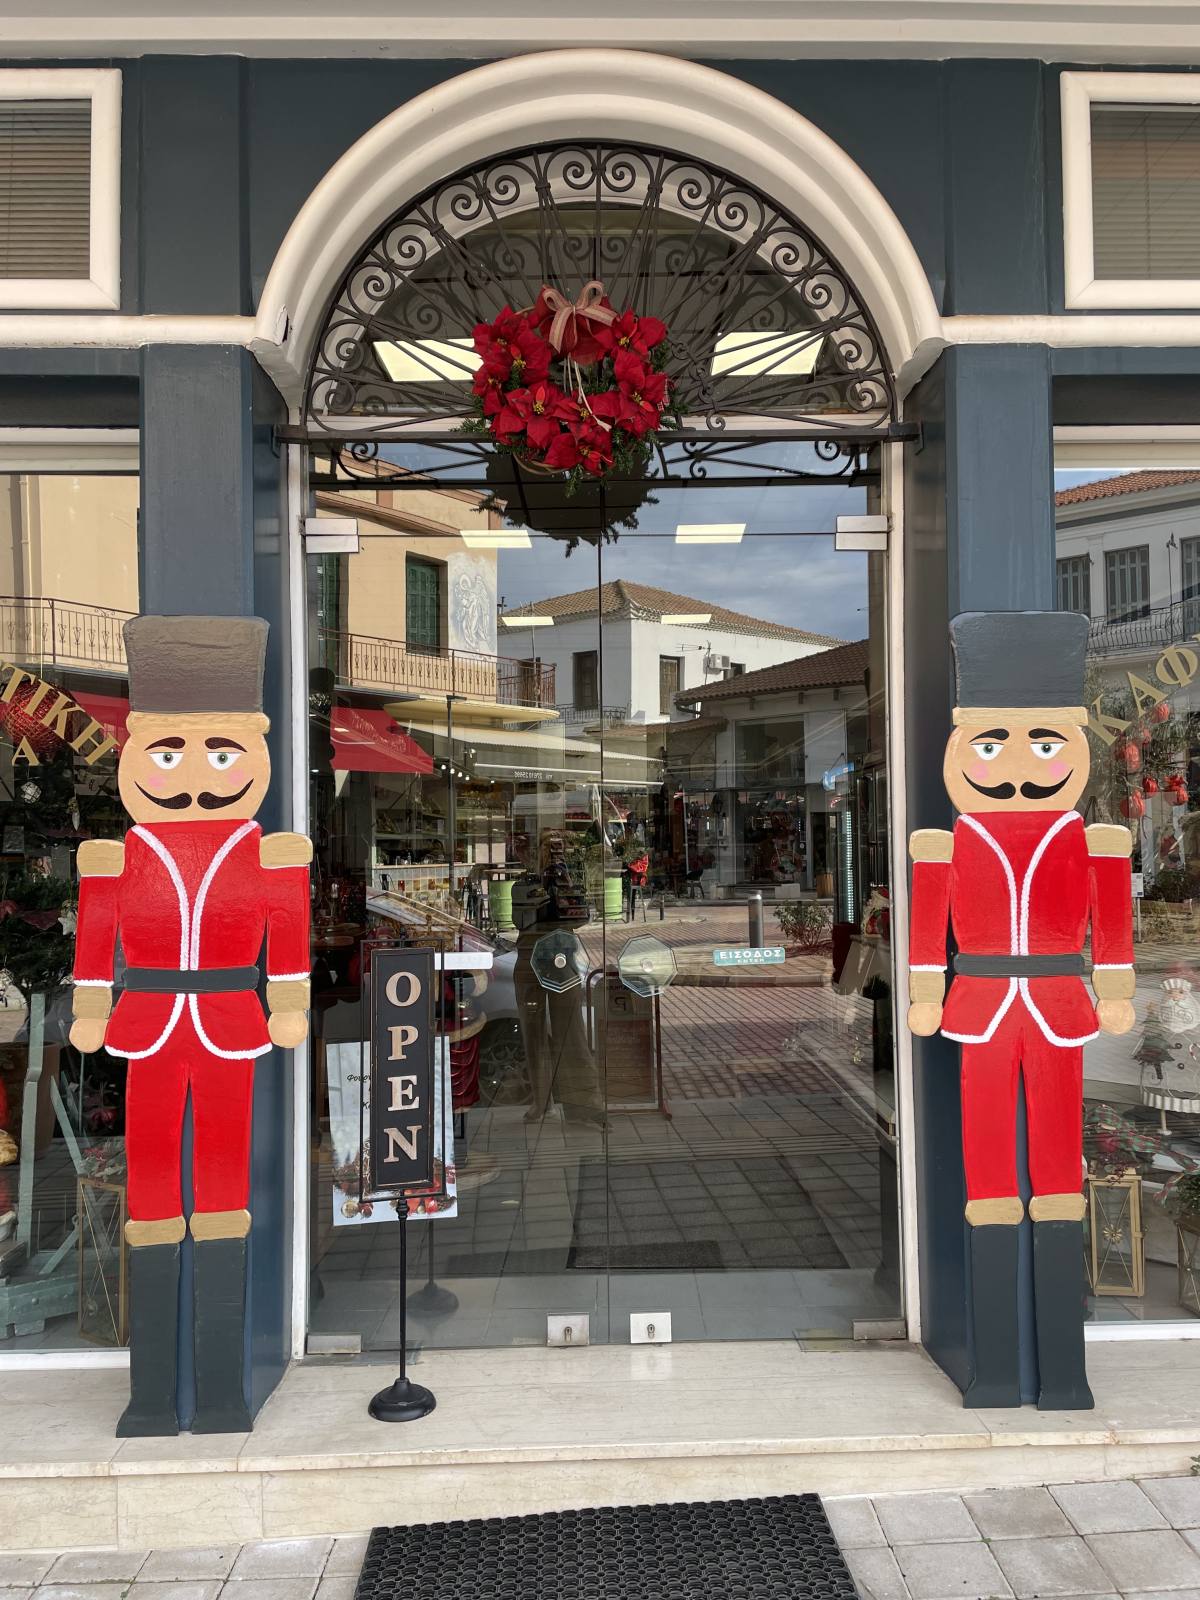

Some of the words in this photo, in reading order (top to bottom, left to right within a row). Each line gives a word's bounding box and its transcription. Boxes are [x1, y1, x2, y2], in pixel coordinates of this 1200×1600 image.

[1088, 633, 1200, 746] ΚΑΦ
[719, 949, 782, 960] ΕΙΣΟΔΟΣ
[384, 971, 423, 1163] OPEN
